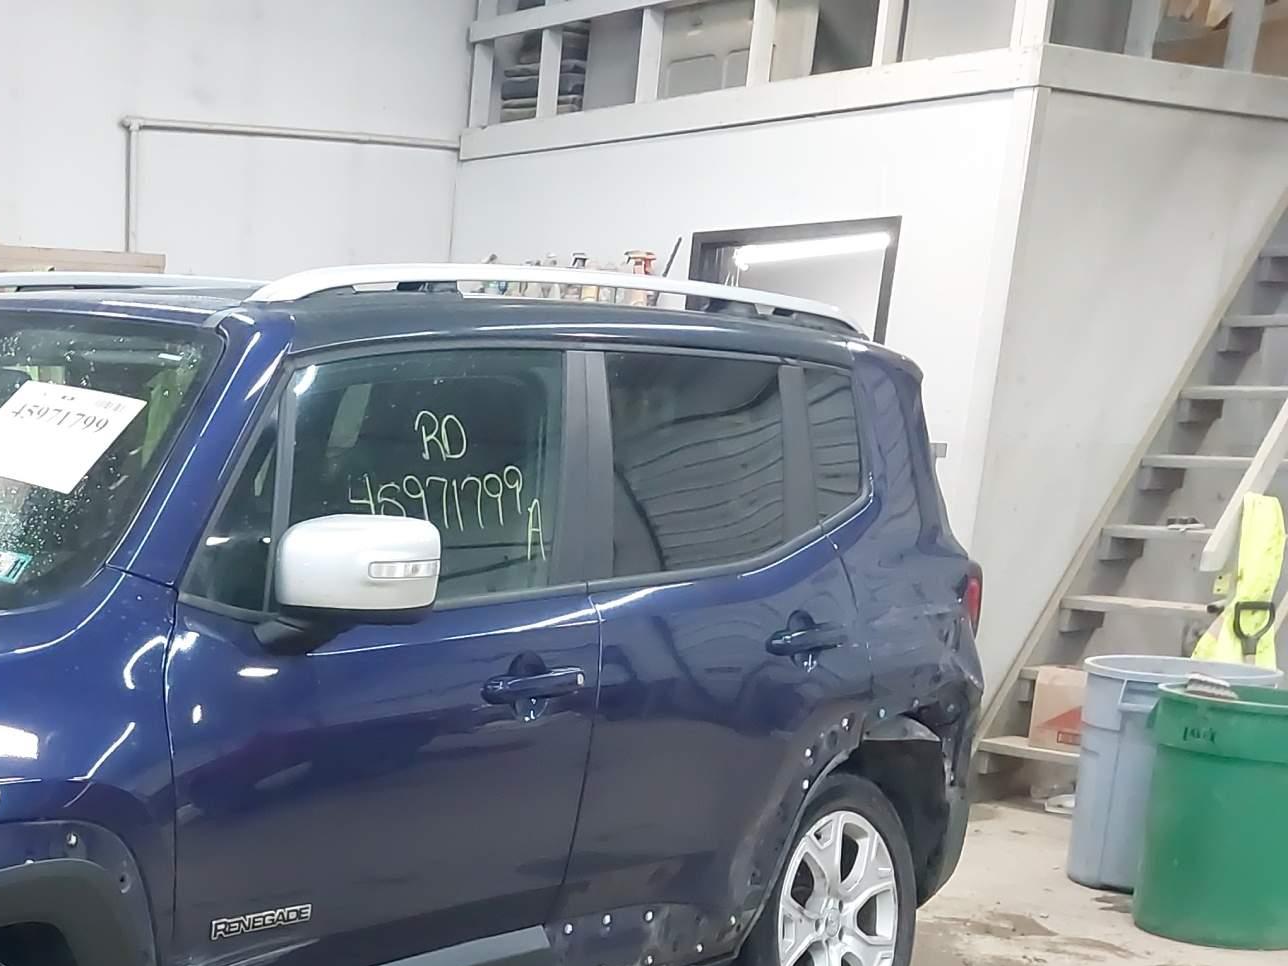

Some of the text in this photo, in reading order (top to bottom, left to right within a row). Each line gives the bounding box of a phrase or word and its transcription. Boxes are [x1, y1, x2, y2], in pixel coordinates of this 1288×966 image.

[414, 410, 467, 461] RD
[527, 498, 546, 561] A
[211, 903, 312, 941] RENEGADE
